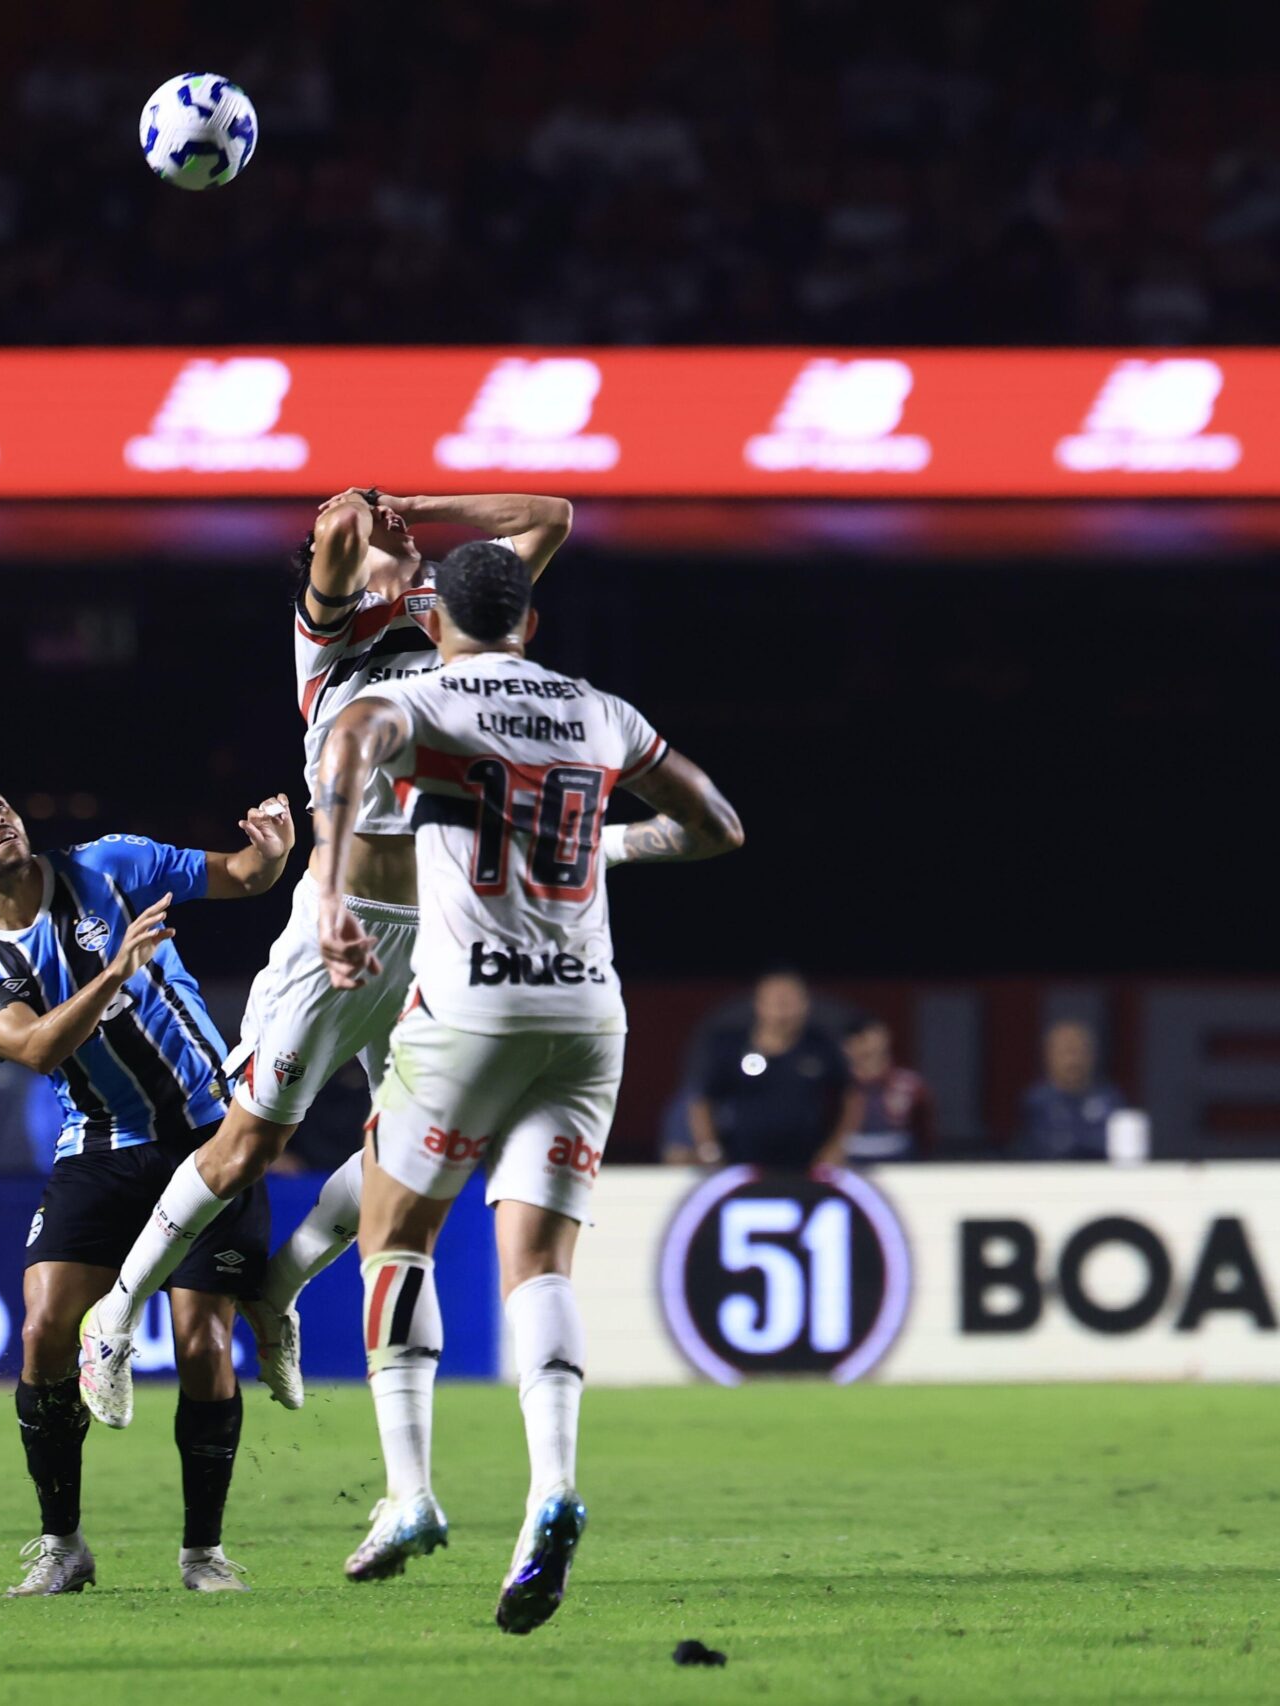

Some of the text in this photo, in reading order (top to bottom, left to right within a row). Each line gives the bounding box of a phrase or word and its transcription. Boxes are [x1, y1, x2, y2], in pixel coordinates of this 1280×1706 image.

[440, 675, 585, 698] SUPERBET
[477, 711, 586, 742] LUCIANO
[465, 754, 606, 903] 10
[470, 941, 586, 987] blue
[718, 1198, 852, 1354] 51
[959, 1214, 1280, 1336] BOA
